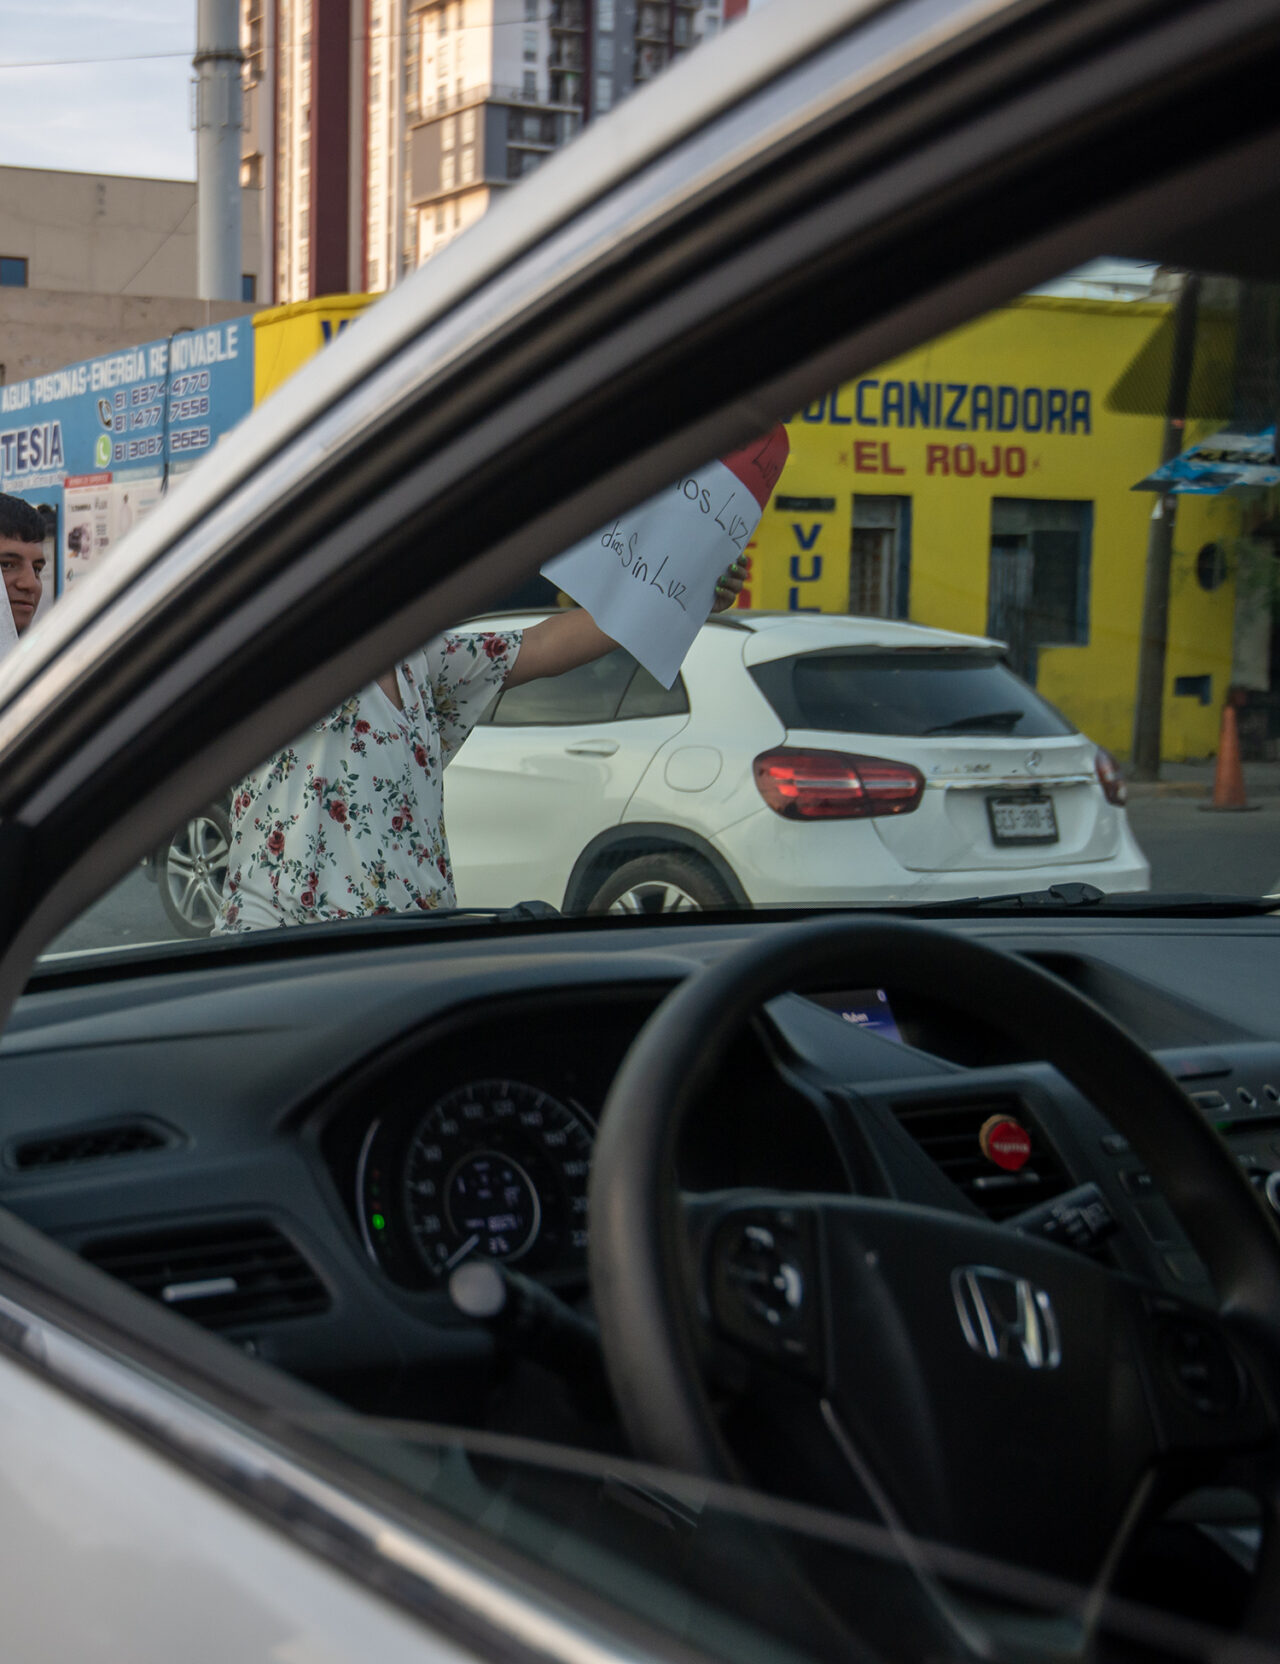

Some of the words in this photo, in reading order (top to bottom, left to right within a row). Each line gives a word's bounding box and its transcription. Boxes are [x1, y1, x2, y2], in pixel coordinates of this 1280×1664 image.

[149, 325, 239, 377] RENOVABLE
[114, 391, 127, 411] 81
[131, 381, 167, 407] 8374
[171, 371, 210, 397] 4770
[114, 414, 127, 434] 81
[129, 405, 162, 431] 1477
[170, 396, 210, 423] 7558
[0, 421, 64, 476] TESIA
[114, 443, 126, 462] 81
[129, 434, 165, 459] 3087
[171, 427, 210, 452] 2625
[853, 440, 906, 475] EL
[926, 443, 1027, 478] ROJO
[621, 532, 648, 582] Sin
